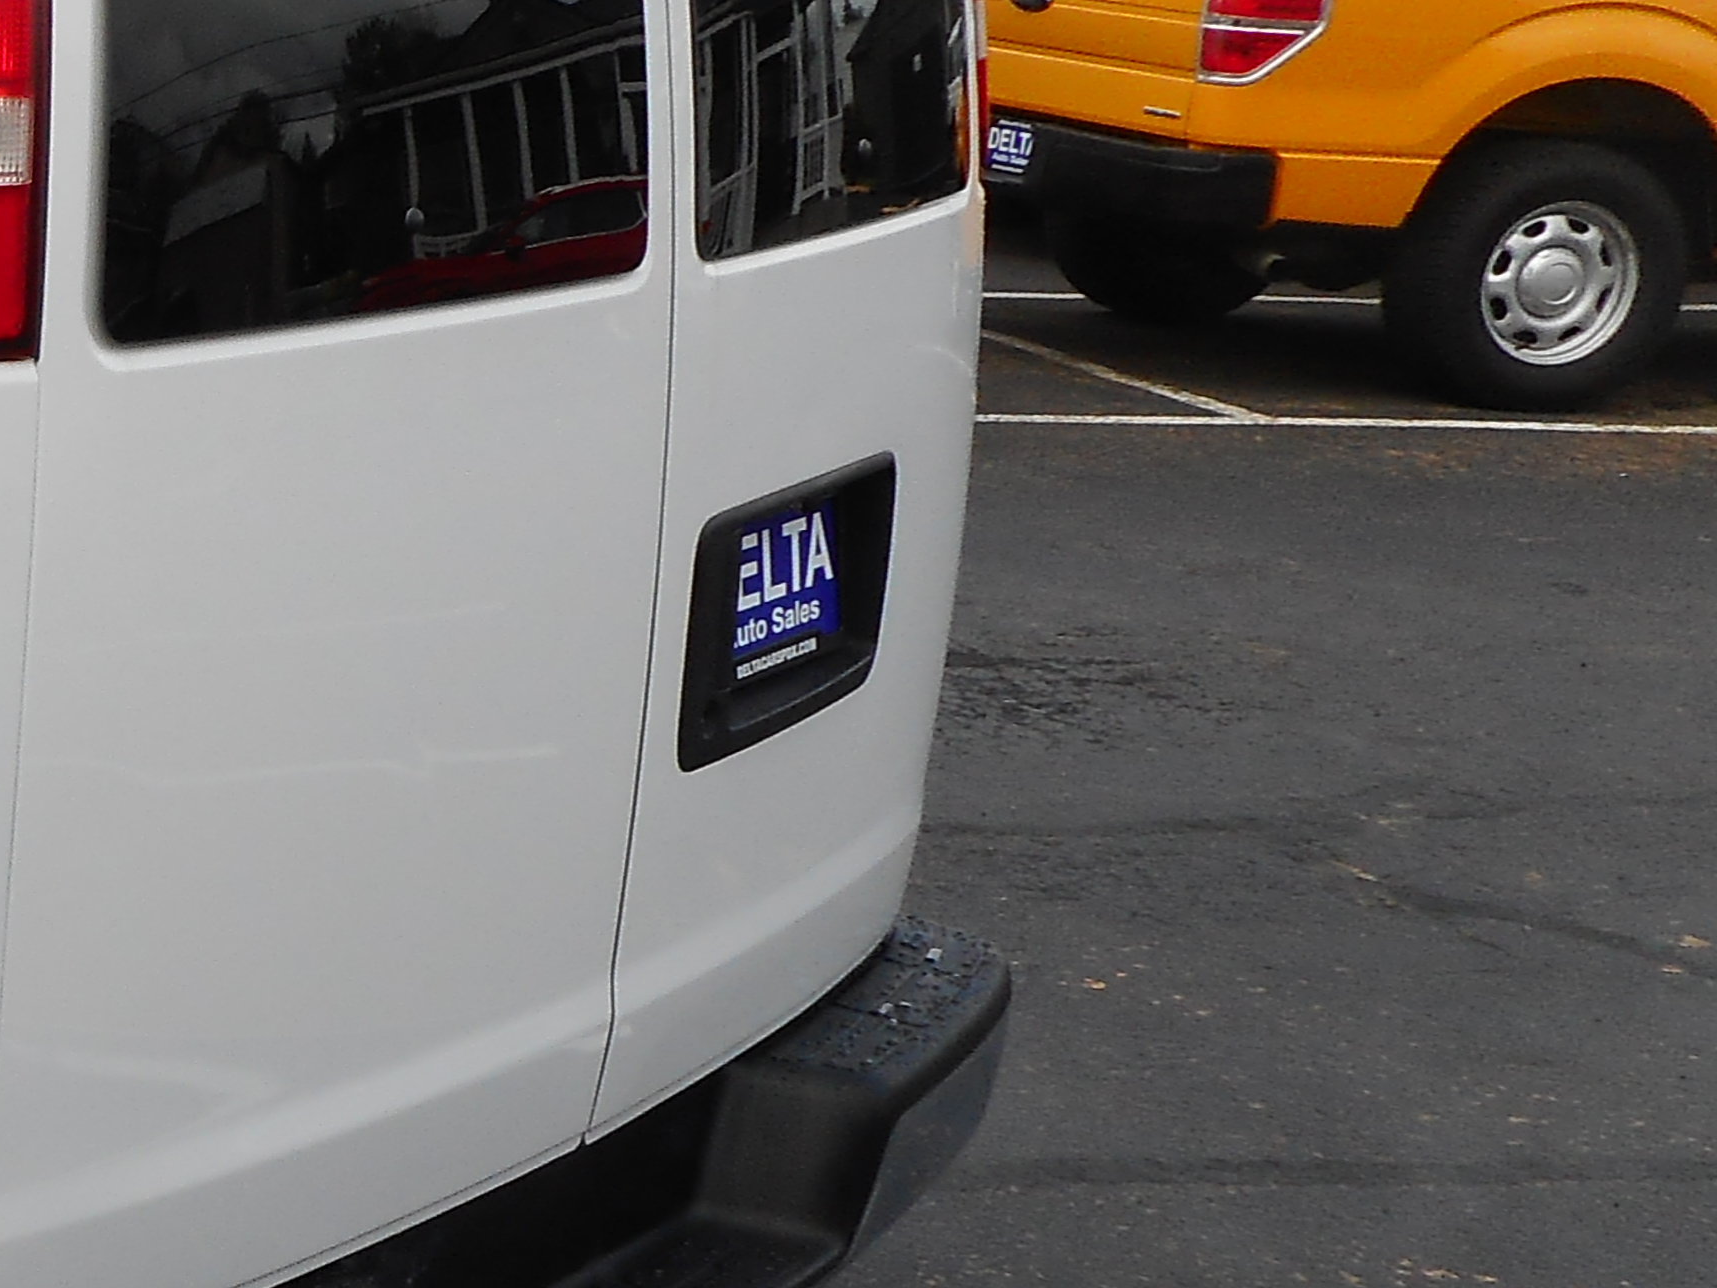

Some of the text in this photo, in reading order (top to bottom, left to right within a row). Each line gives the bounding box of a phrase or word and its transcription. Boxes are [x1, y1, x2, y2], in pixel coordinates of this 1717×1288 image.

[736, 511, 835, 613] ELTA
[733, 599, 821, 649] uto Sales
